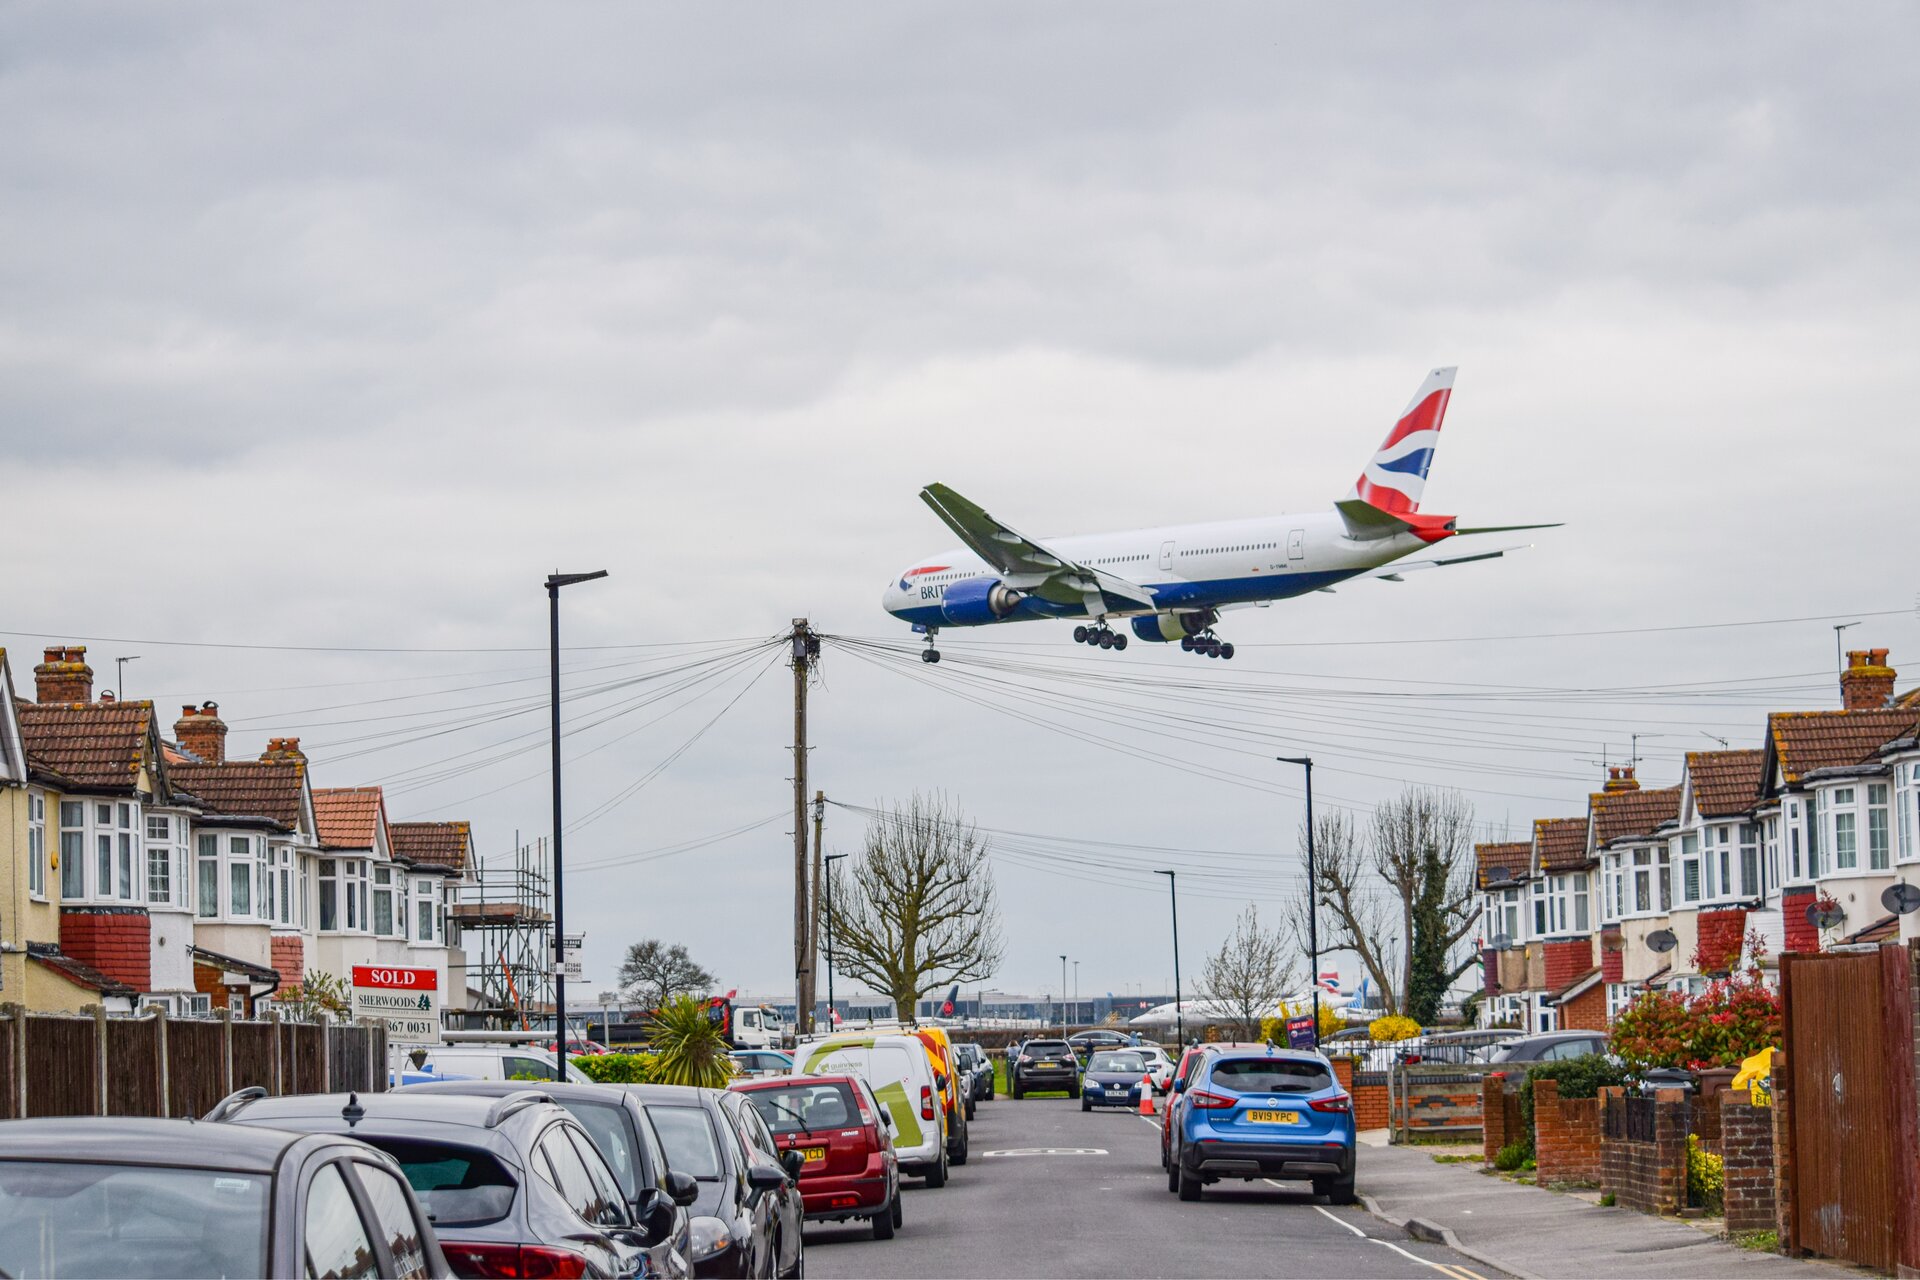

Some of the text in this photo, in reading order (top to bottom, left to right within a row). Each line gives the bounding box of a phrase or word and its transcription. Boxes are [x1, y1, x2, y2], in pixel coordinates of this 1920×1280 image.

[920, 584, 948, 600] BRIT
[371, 970, 415, 984] SOLD
[359, 995, 416, 1007] SHERWOODS
[407, 1022, 431, 1033] 0031
[1252, 1111, 1292, 1121] BV19 YPC
[803, 1148, 824, 1159] TCD
